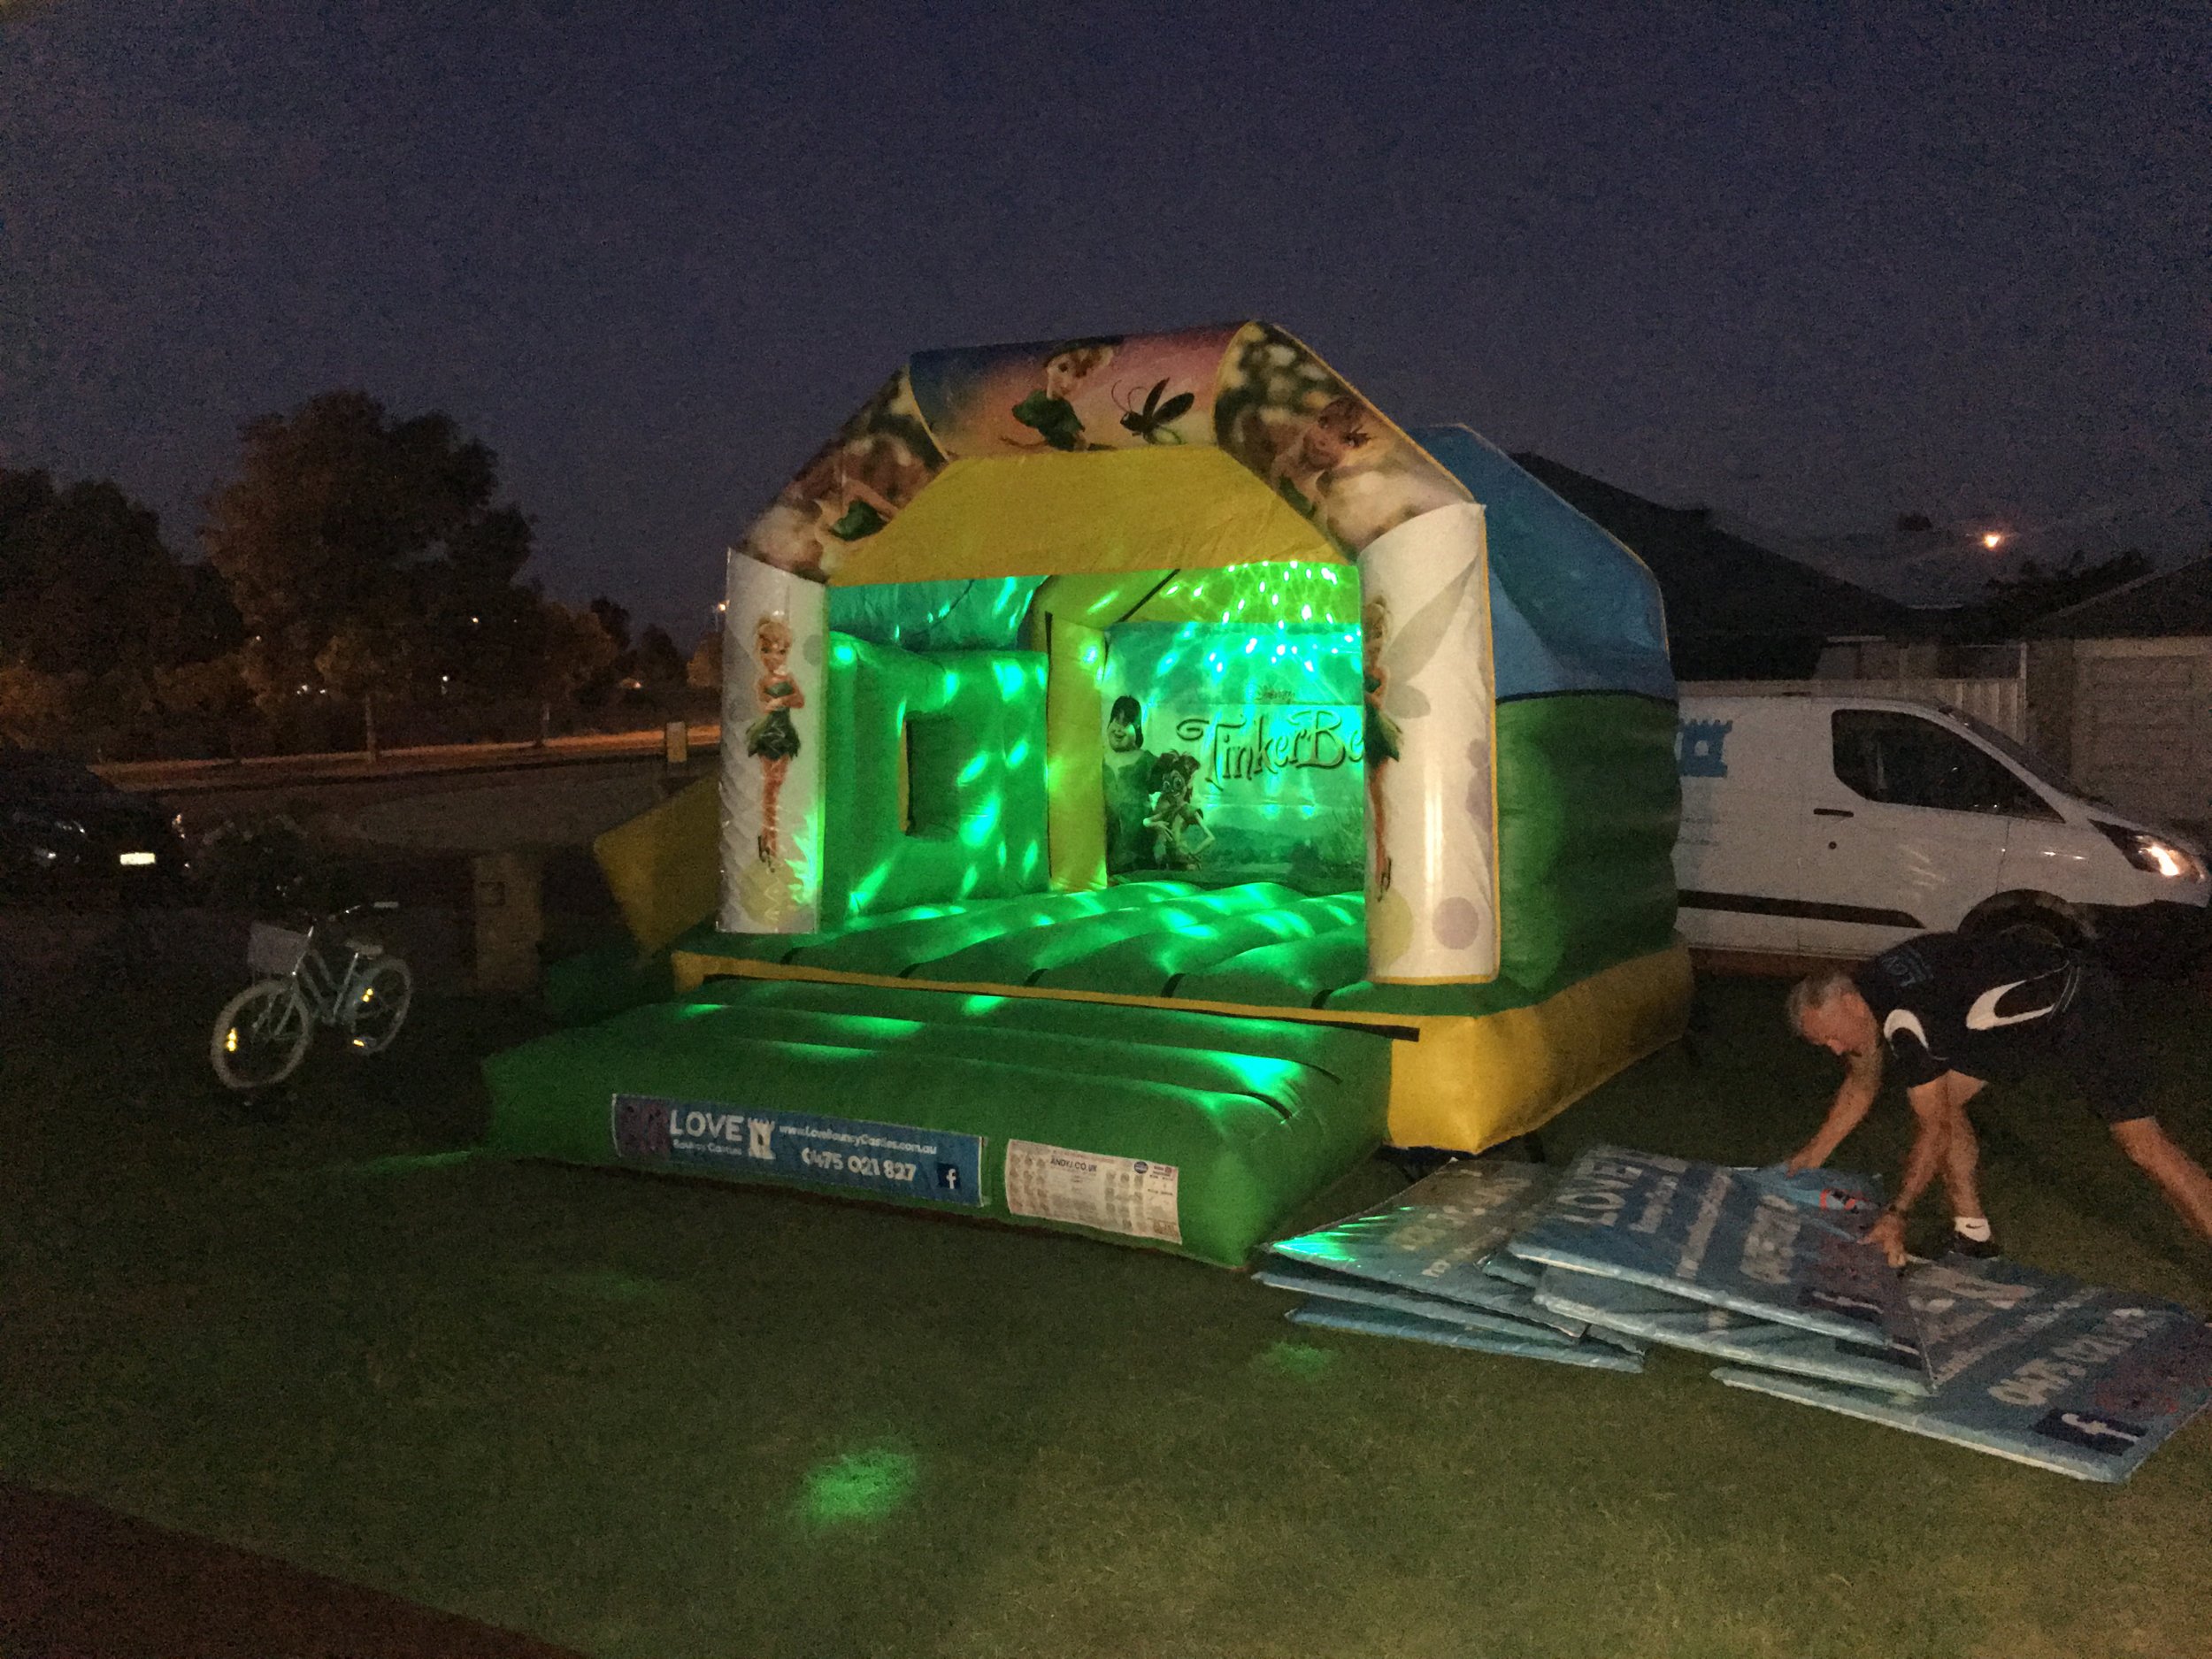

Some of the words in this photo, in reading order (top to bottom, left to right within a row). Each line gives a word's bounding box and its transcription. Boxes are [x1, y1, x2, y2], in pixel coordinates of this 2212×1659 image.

[670, 1110, 745, 1141] LOVE
[848, 1156, 881, 1176] 021
[883, 1160, 917, 1182] 827
